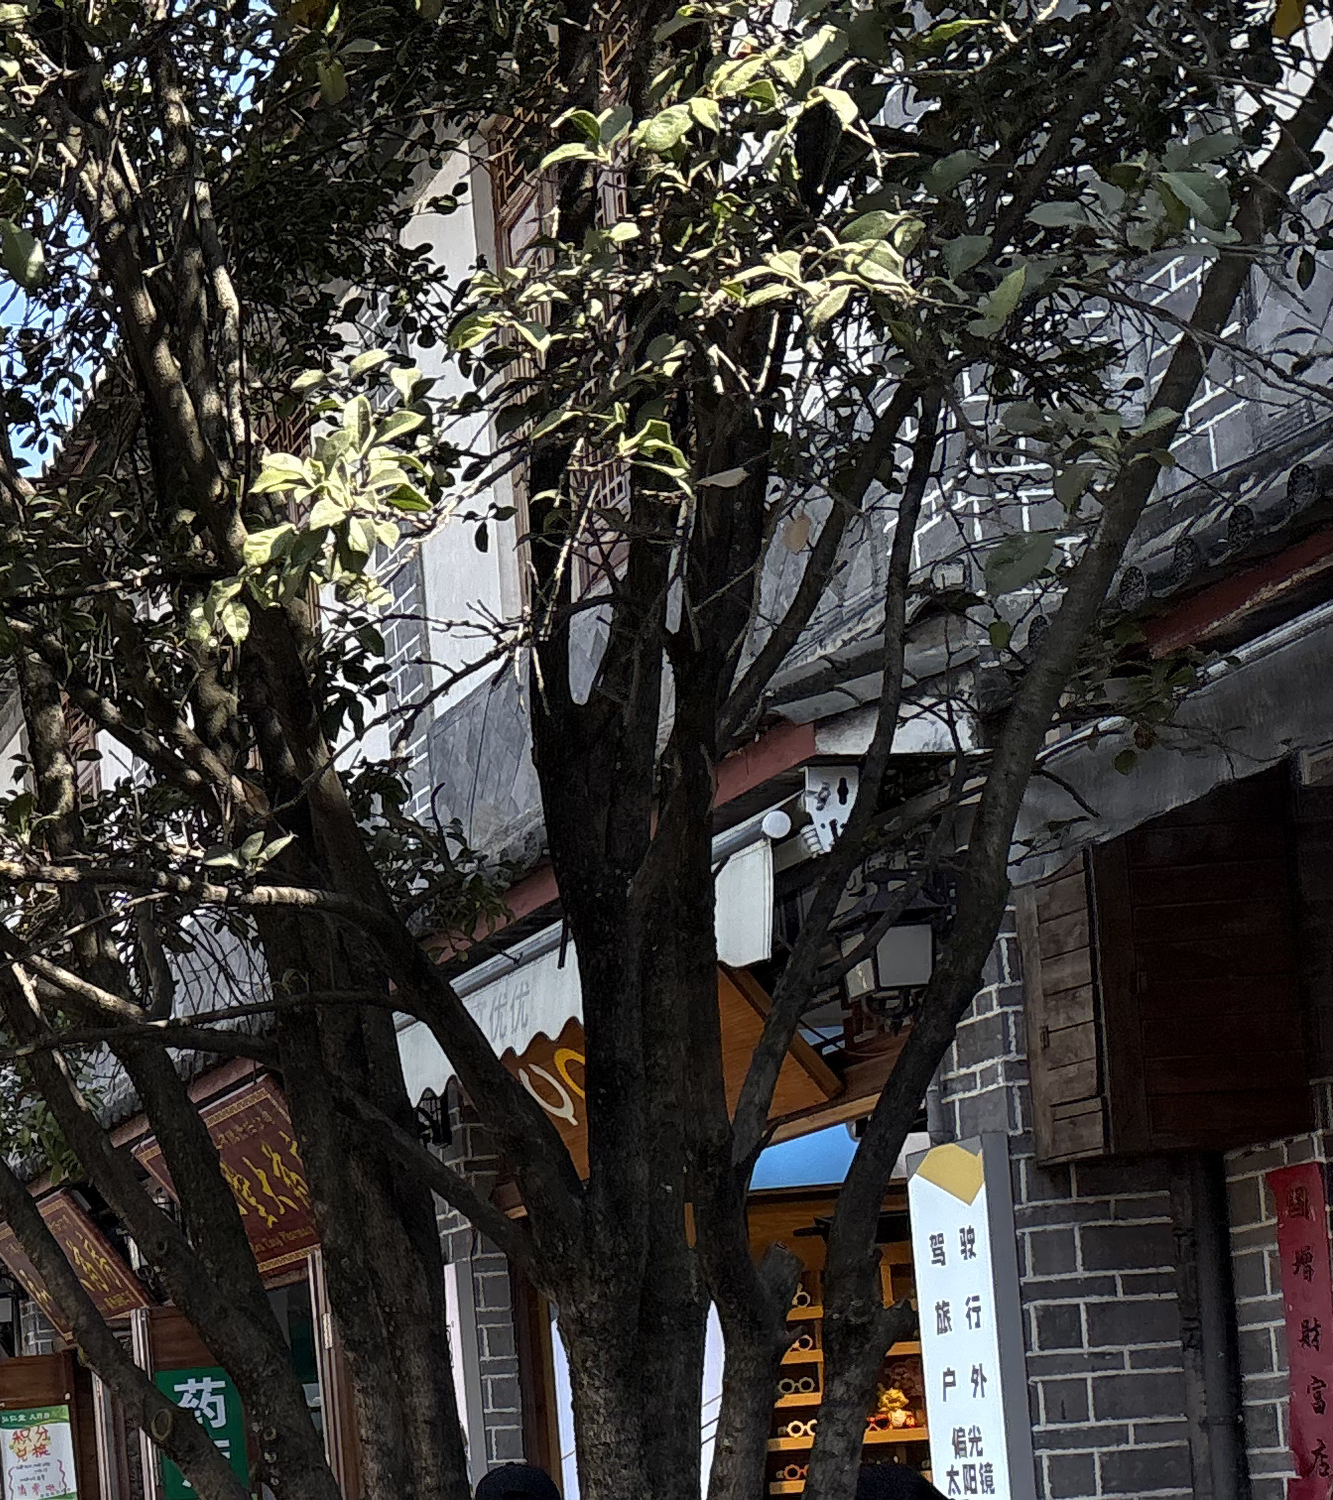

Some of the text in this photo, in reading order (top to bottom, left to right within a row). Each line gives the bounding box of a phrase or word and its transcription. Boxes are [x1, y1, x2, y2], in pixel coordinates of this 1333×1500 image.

[928, 1224, 977, 1267] 驾驶
[934, 1294, 982, 1335] 旅行
[941, 1362, 988, 1402] 户外
[951, 1424, 984, 1459] 偏光
[945, 1461, 996, 1496] 太阳镜
